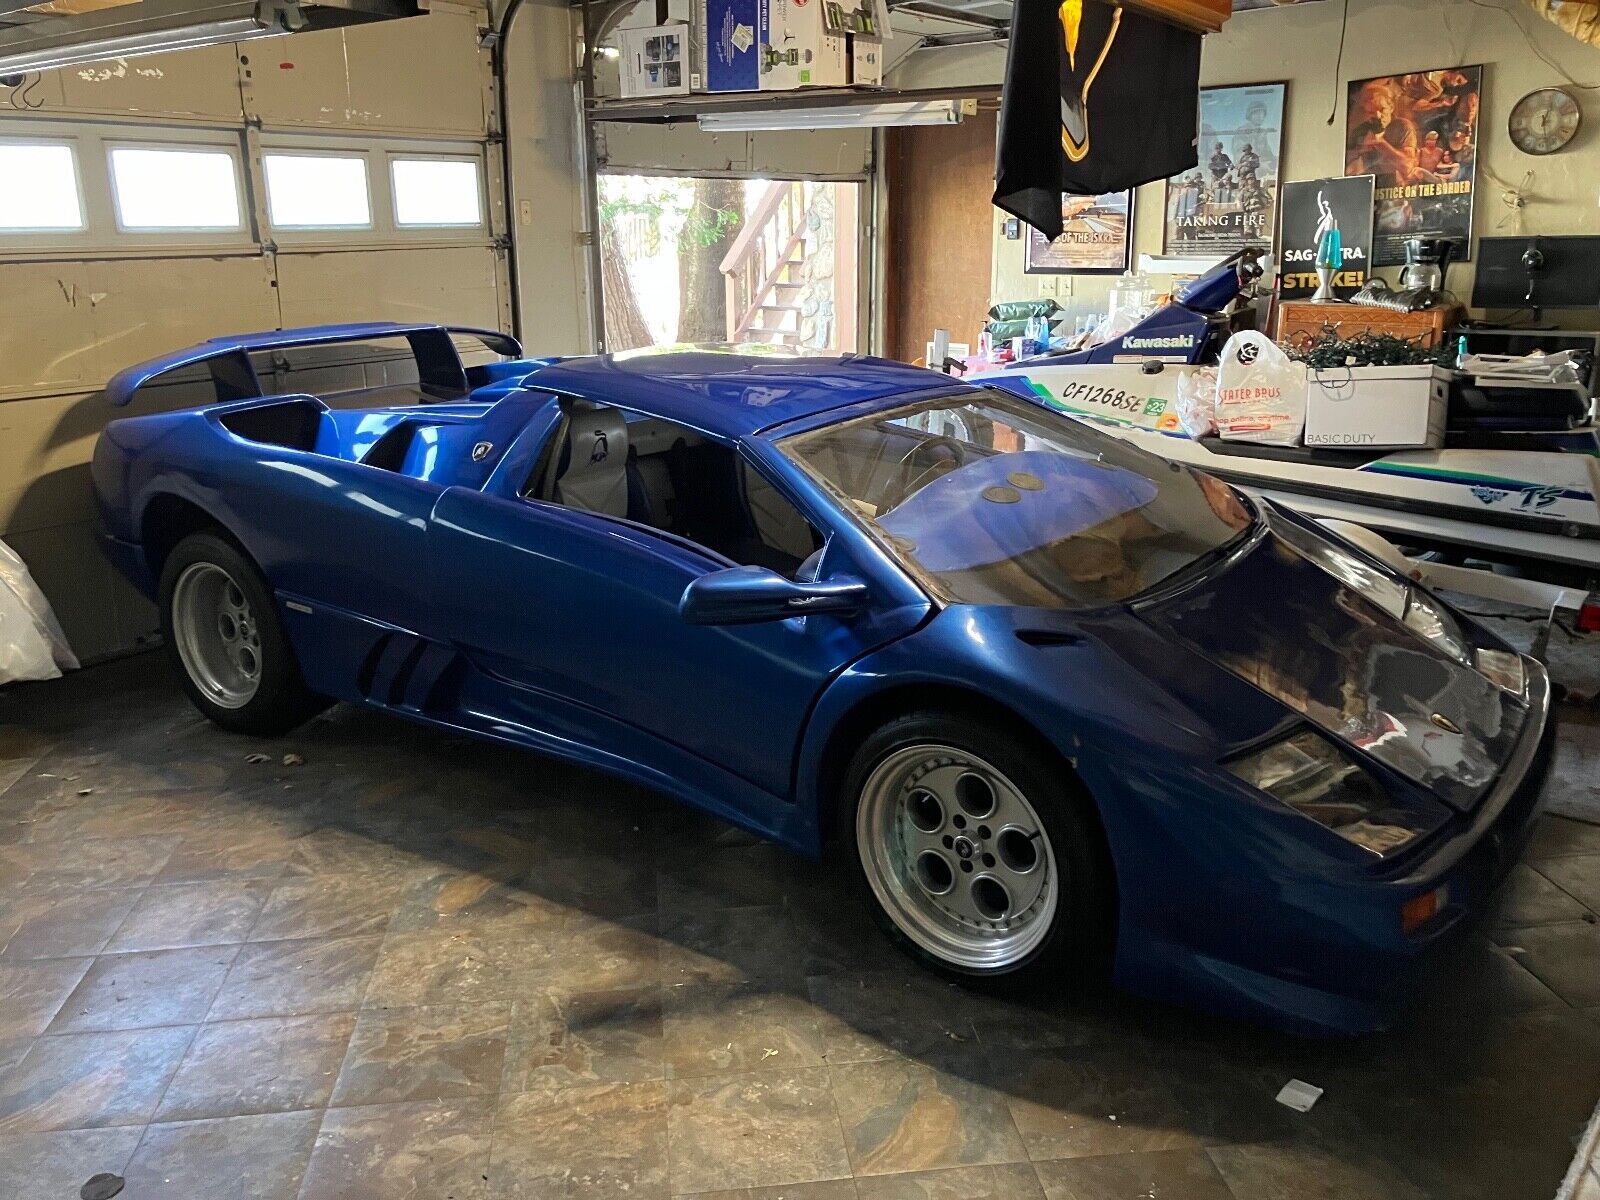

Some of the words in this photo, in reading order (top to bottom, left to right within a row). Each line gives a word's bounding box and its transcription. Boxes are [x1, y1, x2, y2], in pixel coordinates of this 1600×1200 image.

[1404, 185, 1417, 199] ON
[1419, 183, 1435, 197] THE
[1435, 180, 1471, 196] BORDER
[1176, 215, 1229, 227] TAKING
[1234, 213, 1265, 226] FIRE
[1061, 232, 1071, 244] OF
[1073, 231, 1089, 244] THE
[1283, 271, 1364, 289] STRKE!
[1121, 334, 1194, 349] Kawasaki
[1307, 434, 1340, 444] BASIC
[1343, 434, 1376, 444] DUTY
